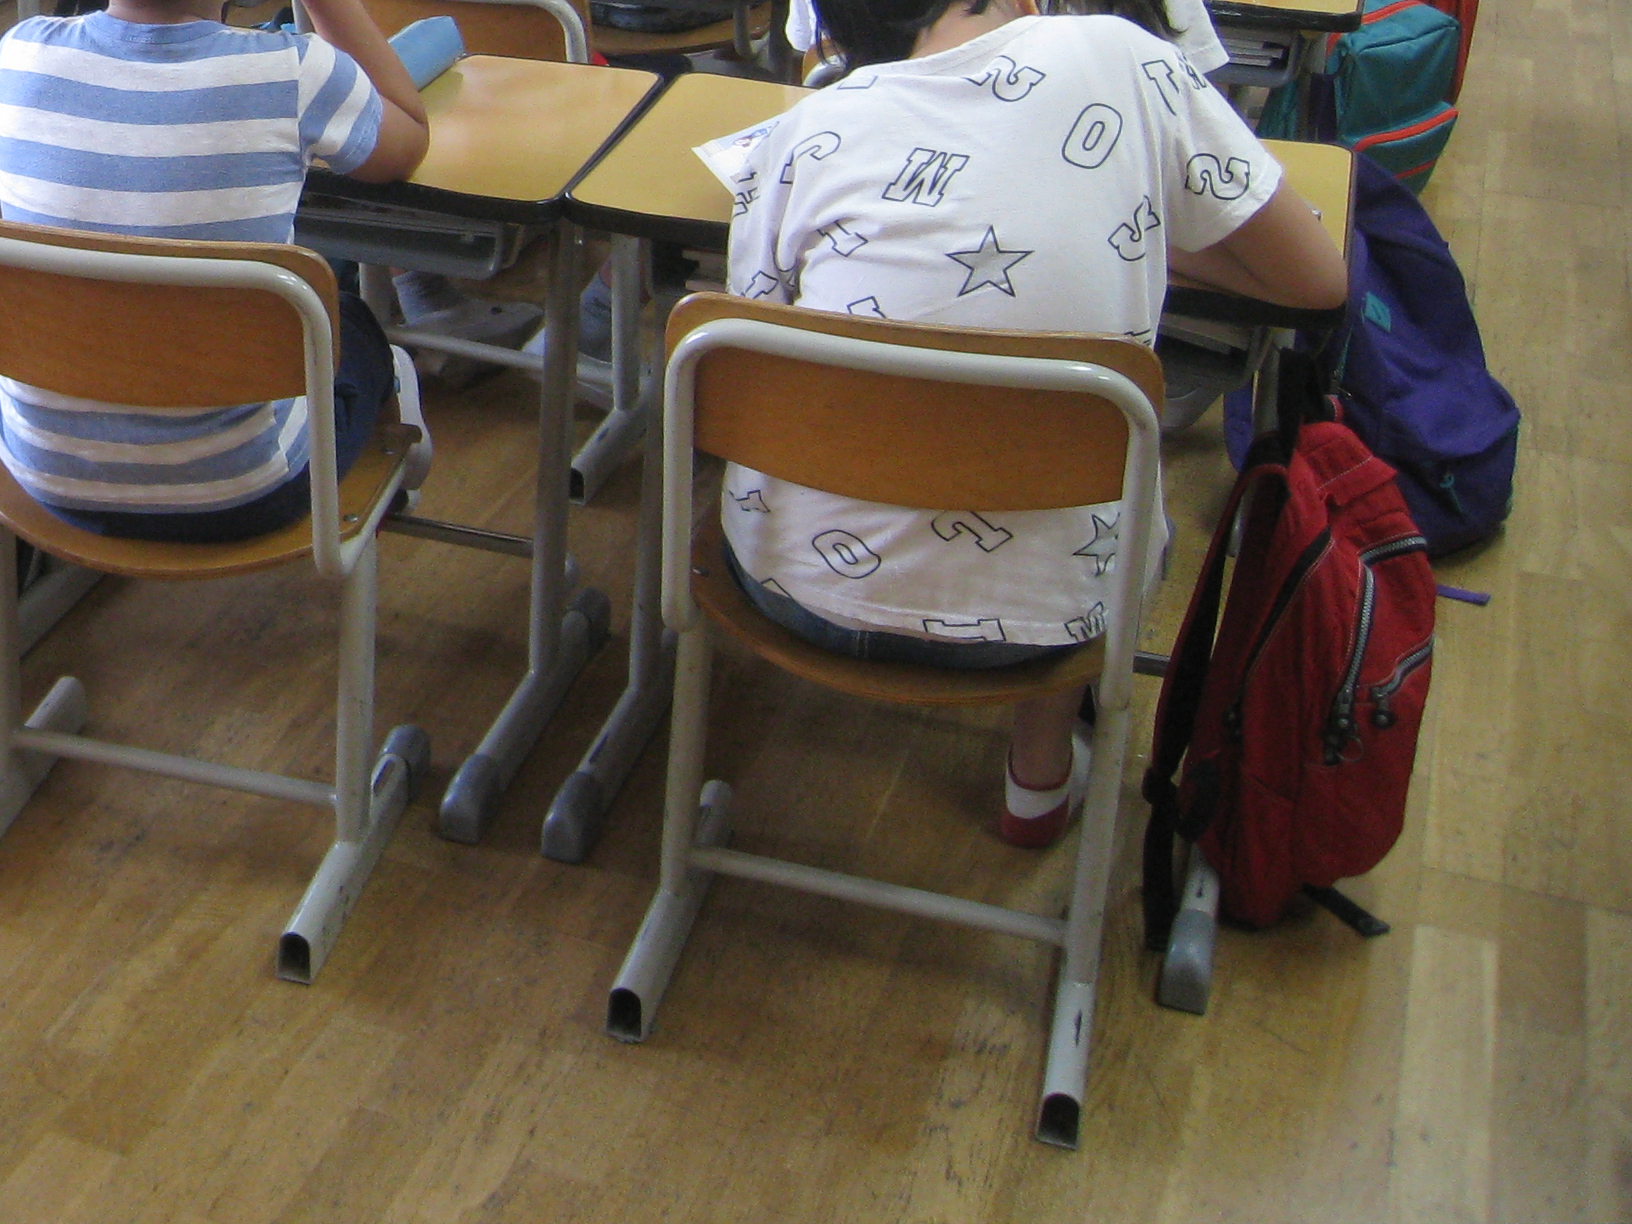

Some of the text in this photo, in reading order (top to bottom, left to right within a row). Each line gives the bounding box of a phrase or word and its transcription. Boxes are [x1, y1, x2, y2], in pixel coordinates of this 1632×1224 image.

[1062, 103, 1123, 169] O
[1184, 153, 1250, 200] S
[812, 509, 881, 579] O
